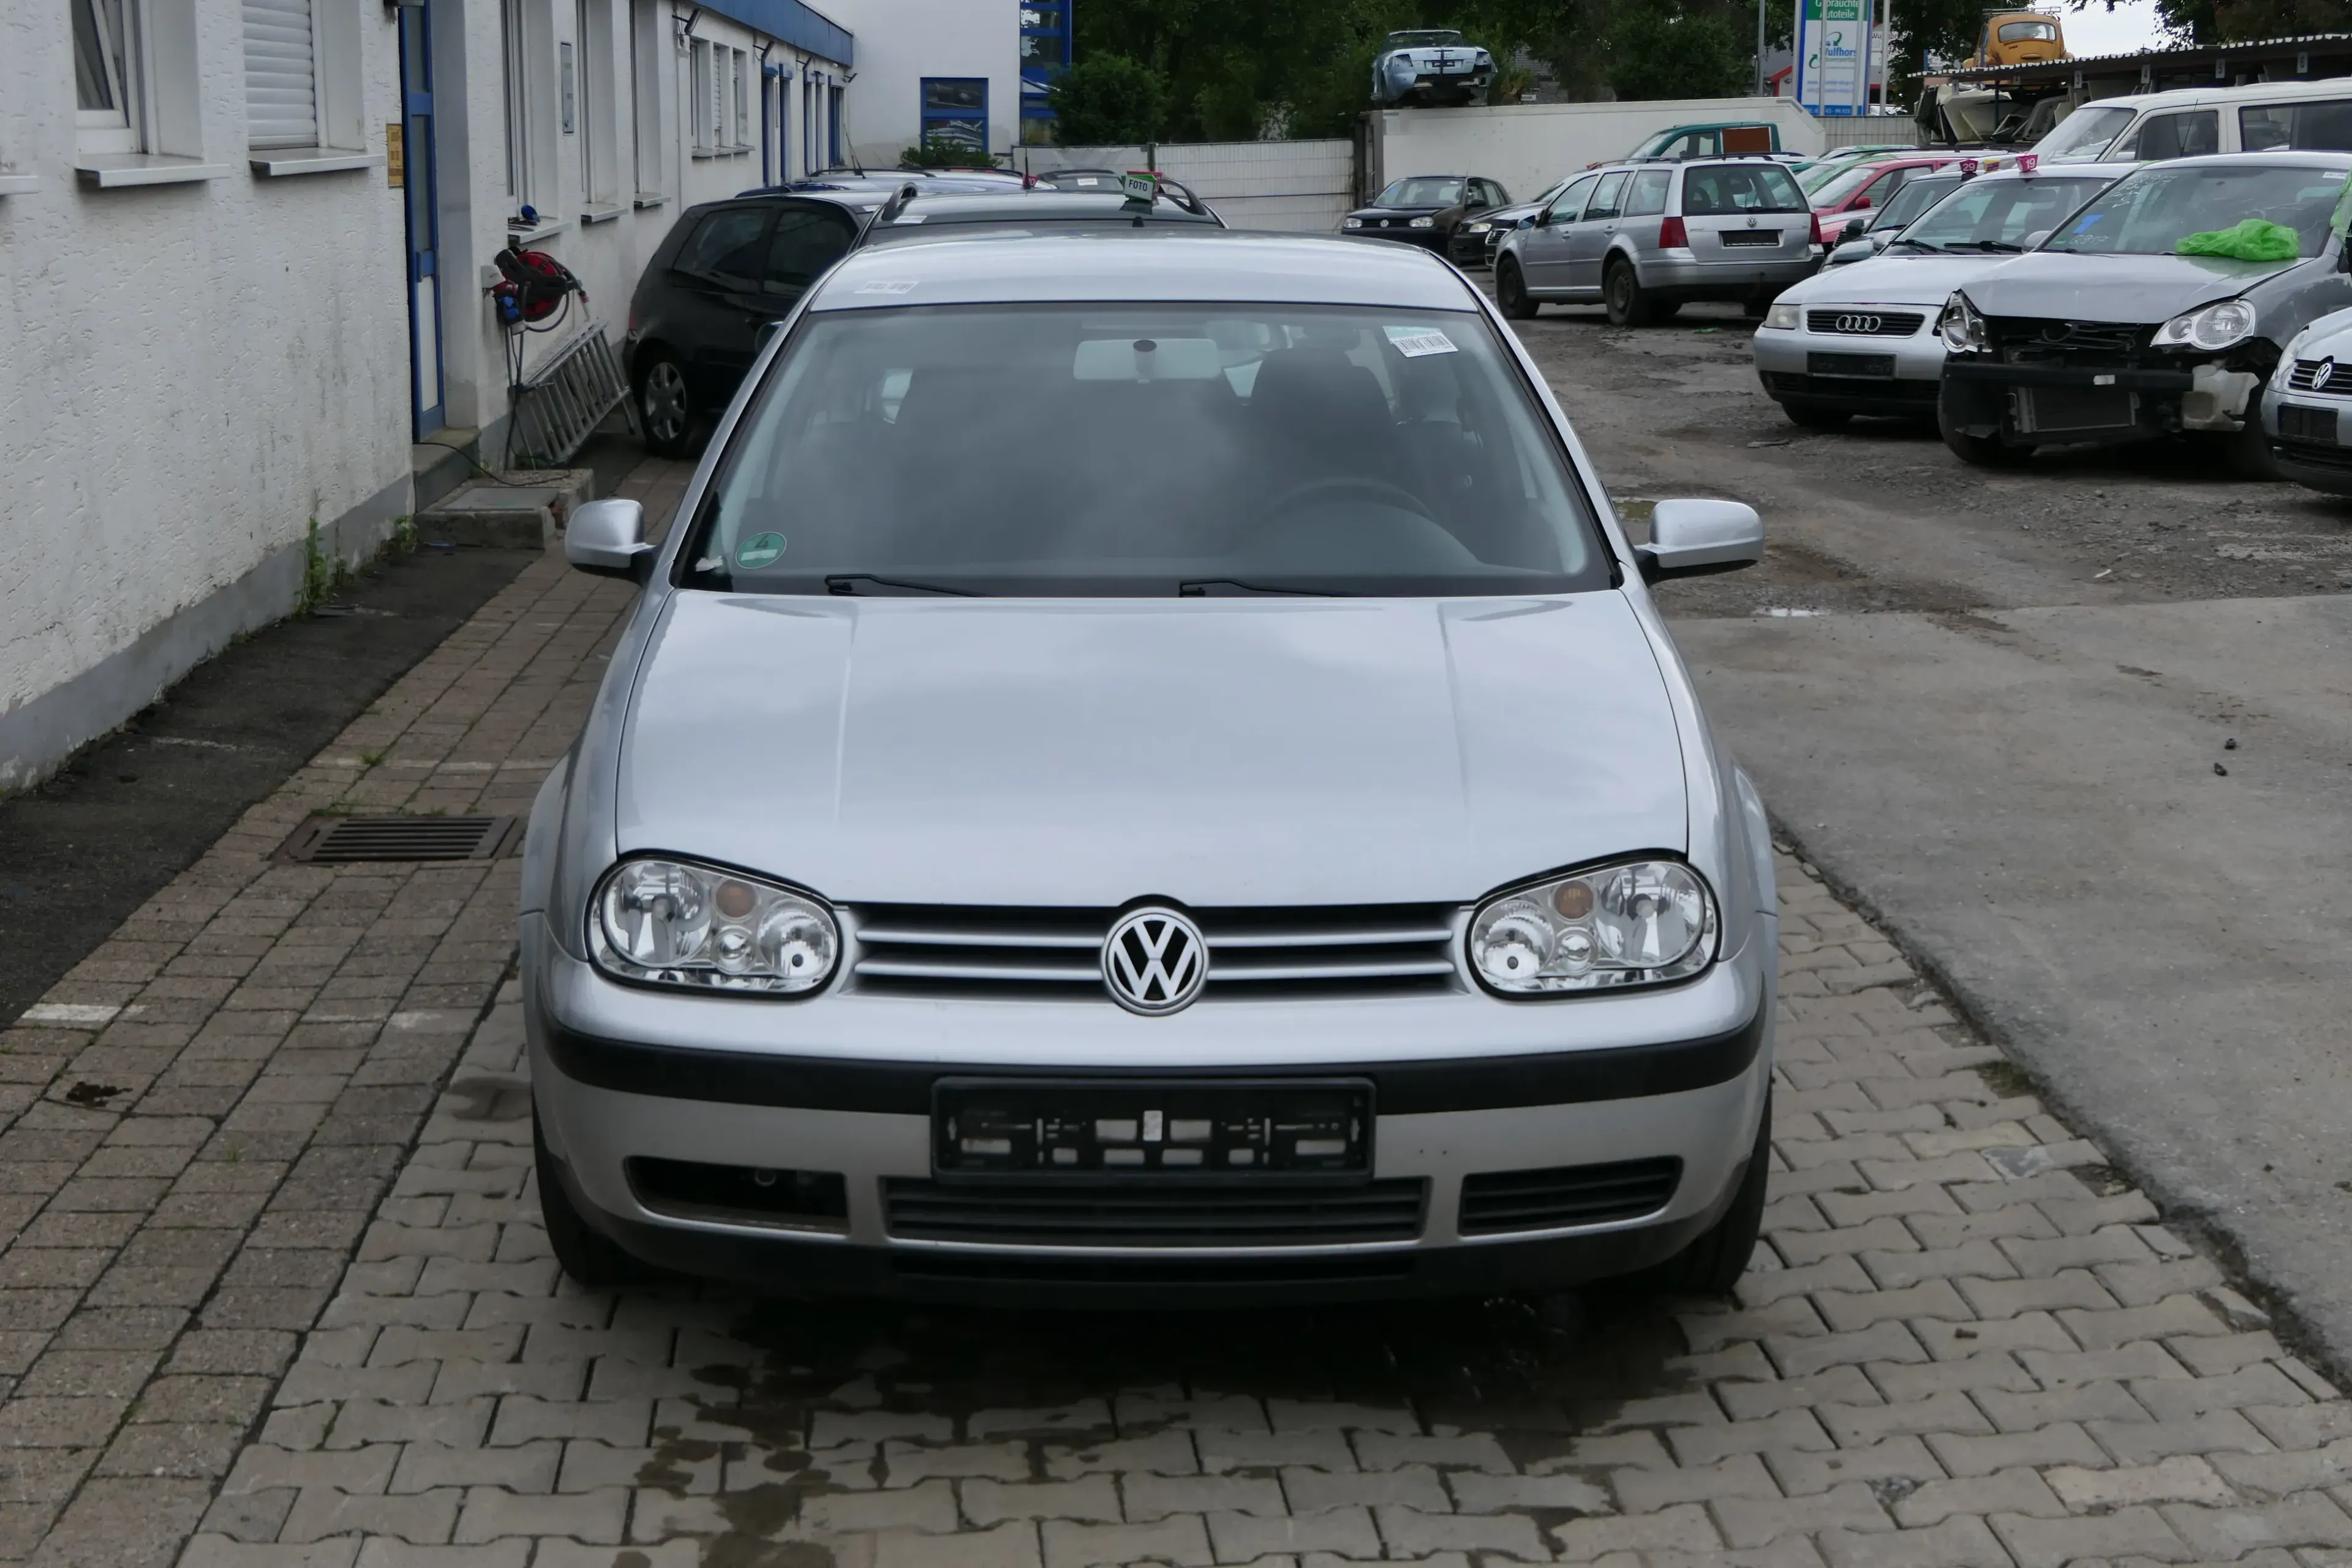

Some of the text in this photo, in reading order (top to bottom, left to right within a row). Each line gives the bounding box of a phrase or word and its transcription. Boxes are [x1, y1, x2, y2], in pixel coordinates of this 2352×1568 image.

[1962, 162, 1975, 172] 29
[2026, 158, 2036, 170] 19
[1128, 179, 1148, 192] FOTO
[2312, 363, 2332, 389] VW
[755, 534, 769, 549] 4
[1101, 907, 1210, 1017] VW
